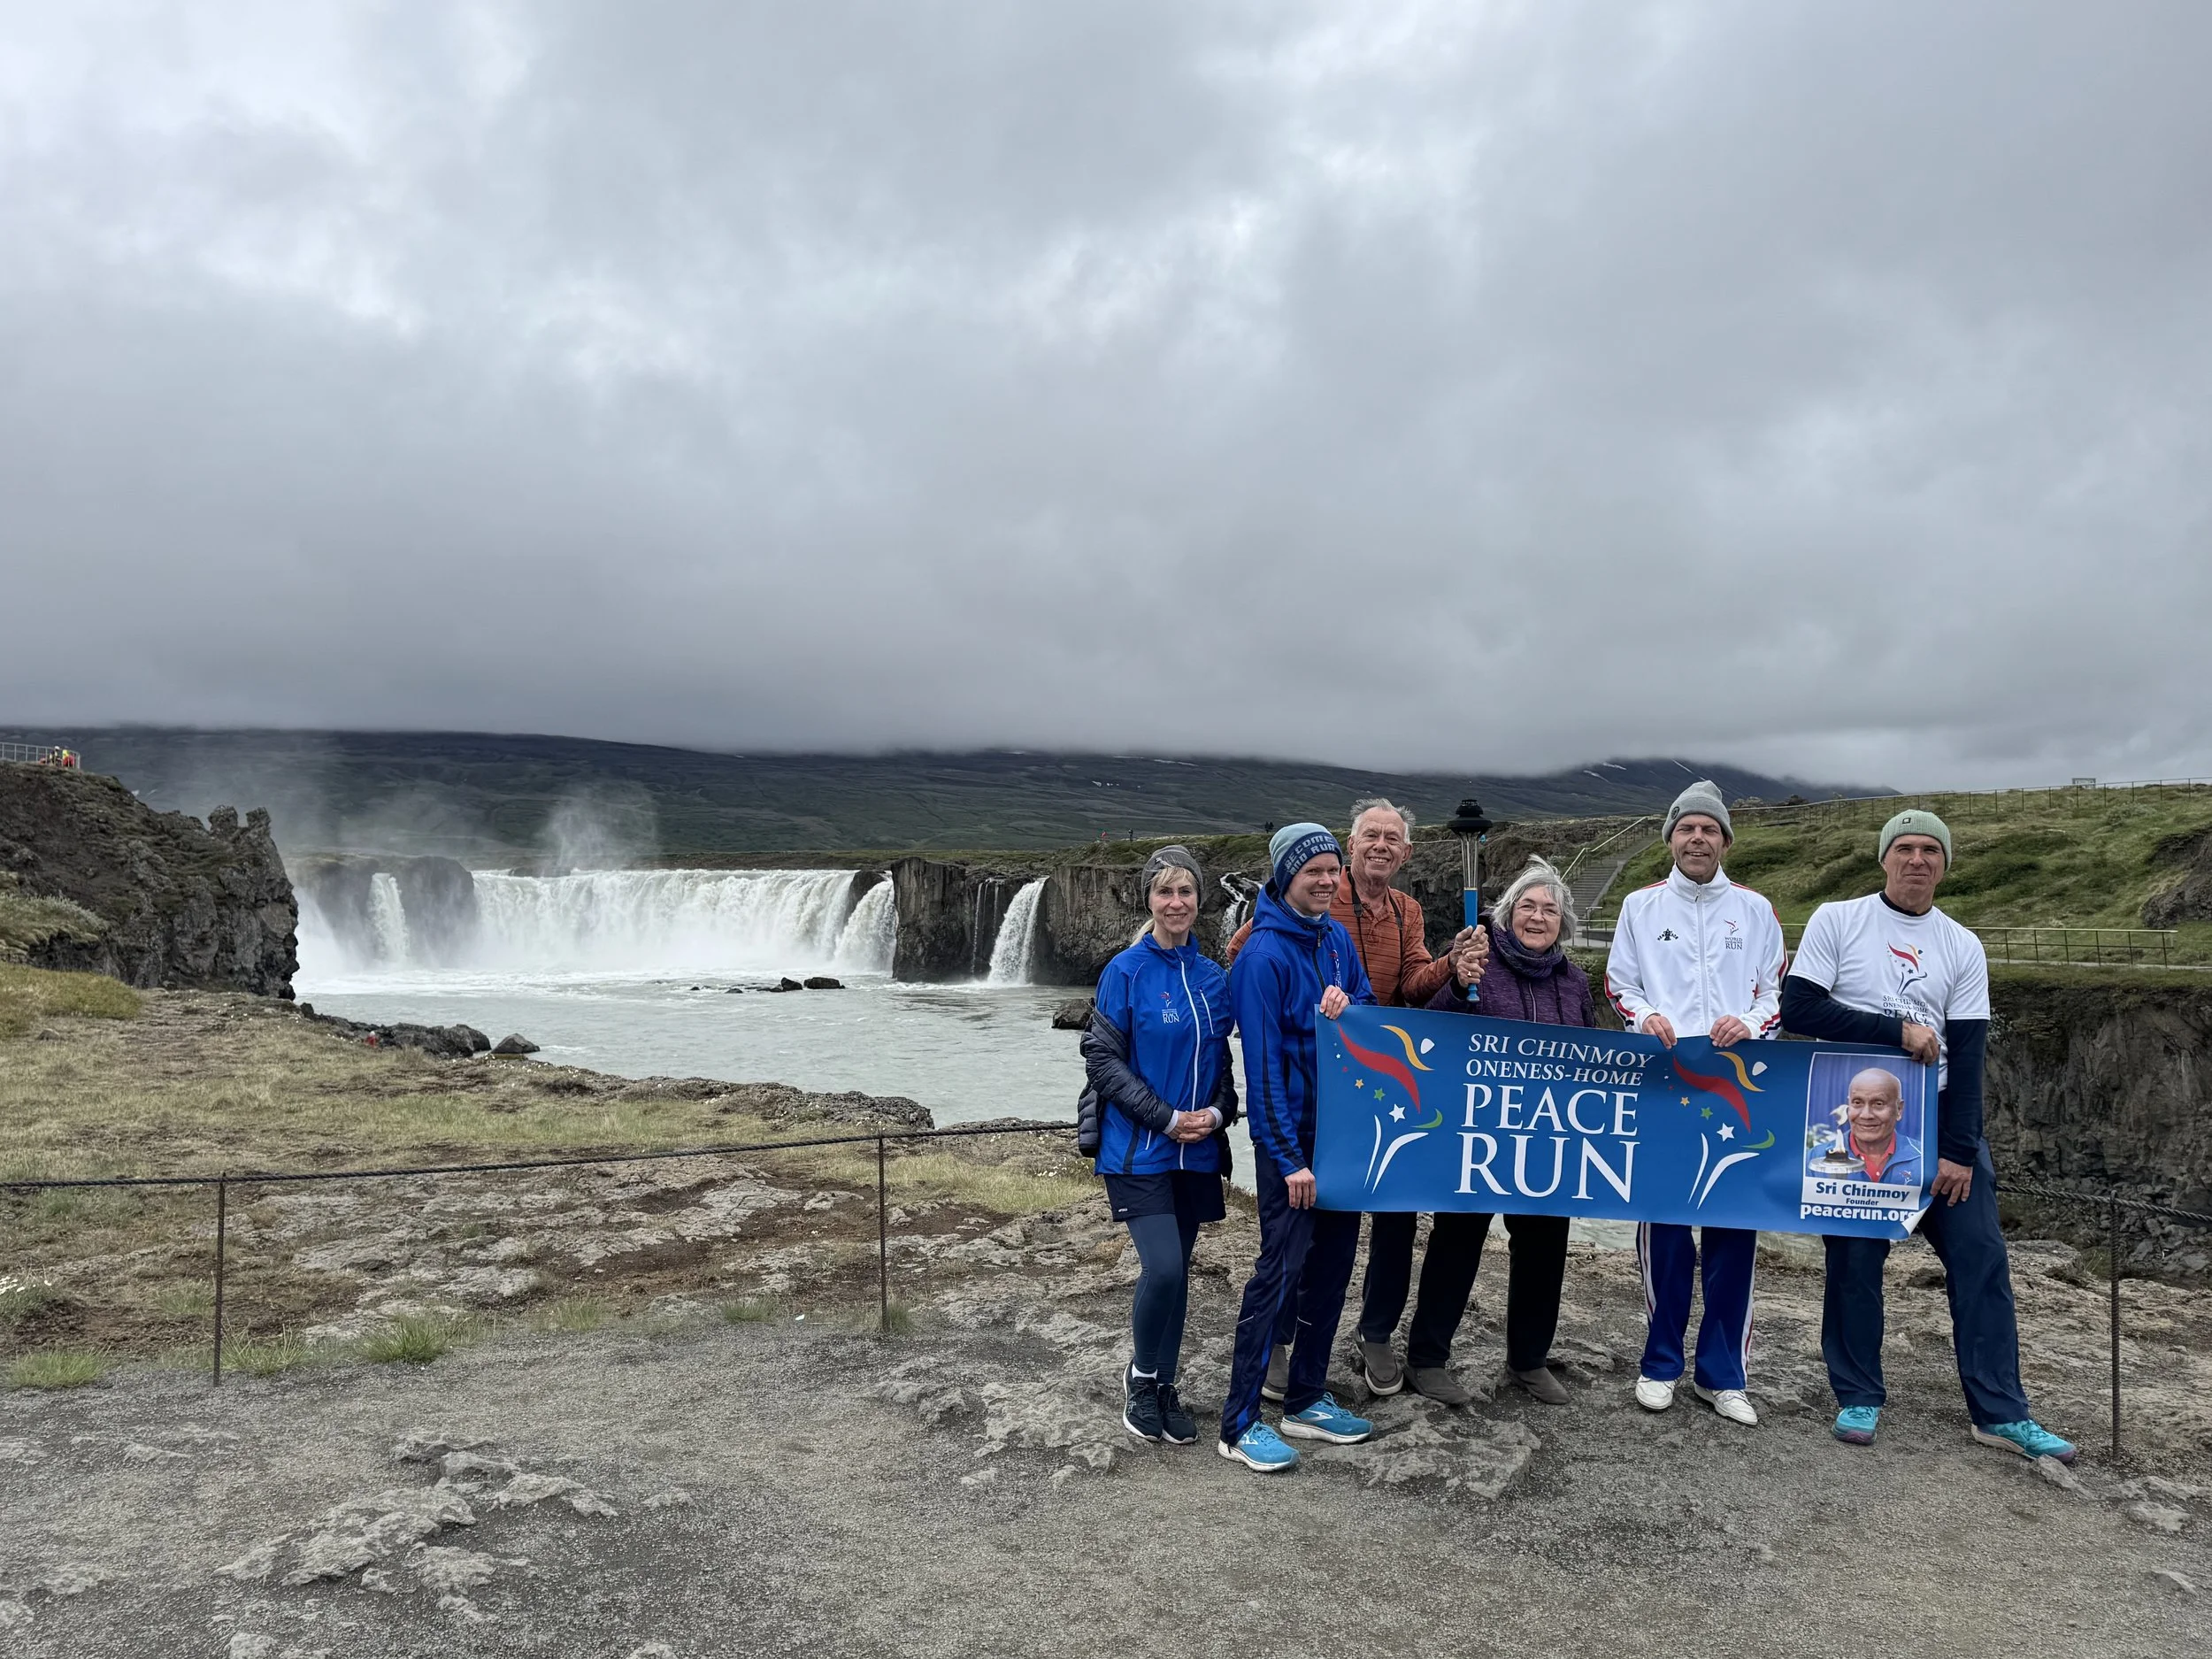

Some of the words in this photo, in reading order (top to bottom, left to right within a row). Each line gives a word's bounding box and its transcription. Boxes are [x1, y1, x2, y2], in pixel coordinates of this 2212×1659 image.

[1469, 1033, 1510, 1053] SRI
[1517, 1038, 1656, 1068] CHINMOY
[1466, 1059, 1643, 1086] ONENESS-HOME
[1461, 1083, 1639, 1136] PEACE
[1455, 1132, 1640, 1203] RUN
[1816, 1181, 1837, 1194] Sri
[1842, 1184, 1910, 1202] Chinmoy
